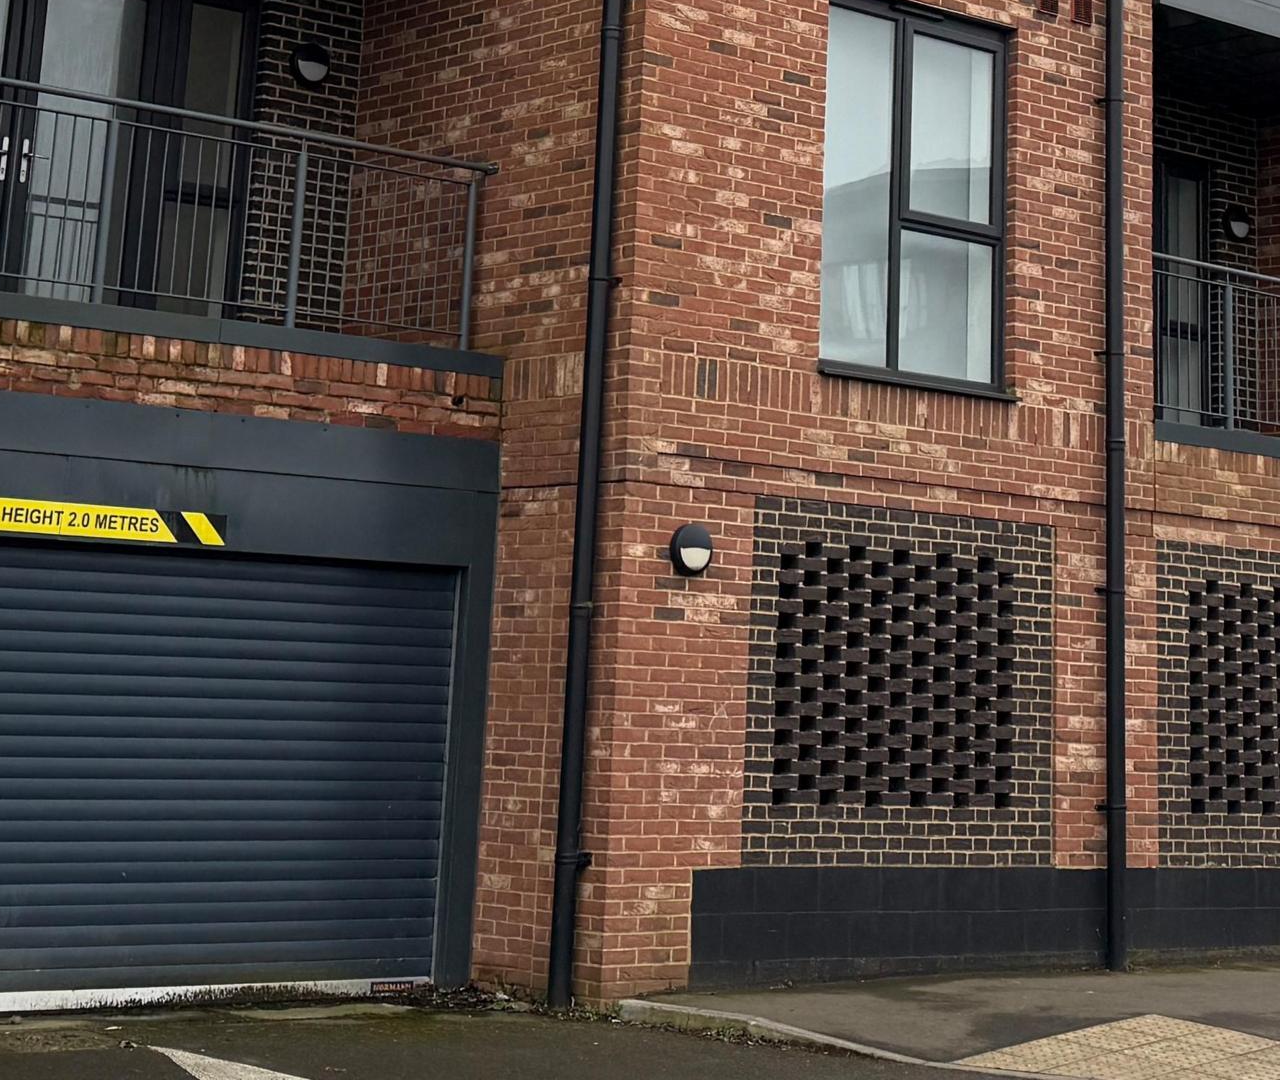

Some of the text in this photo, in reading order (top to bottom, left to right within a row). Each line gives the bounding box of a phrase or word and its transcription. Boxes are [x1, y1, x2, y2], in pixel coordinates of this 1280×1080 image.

[1, 506, 64, 526] HEIGHT
[67, 511, 90, 528] 2.0
[94, 514, 159, 533] METRES
